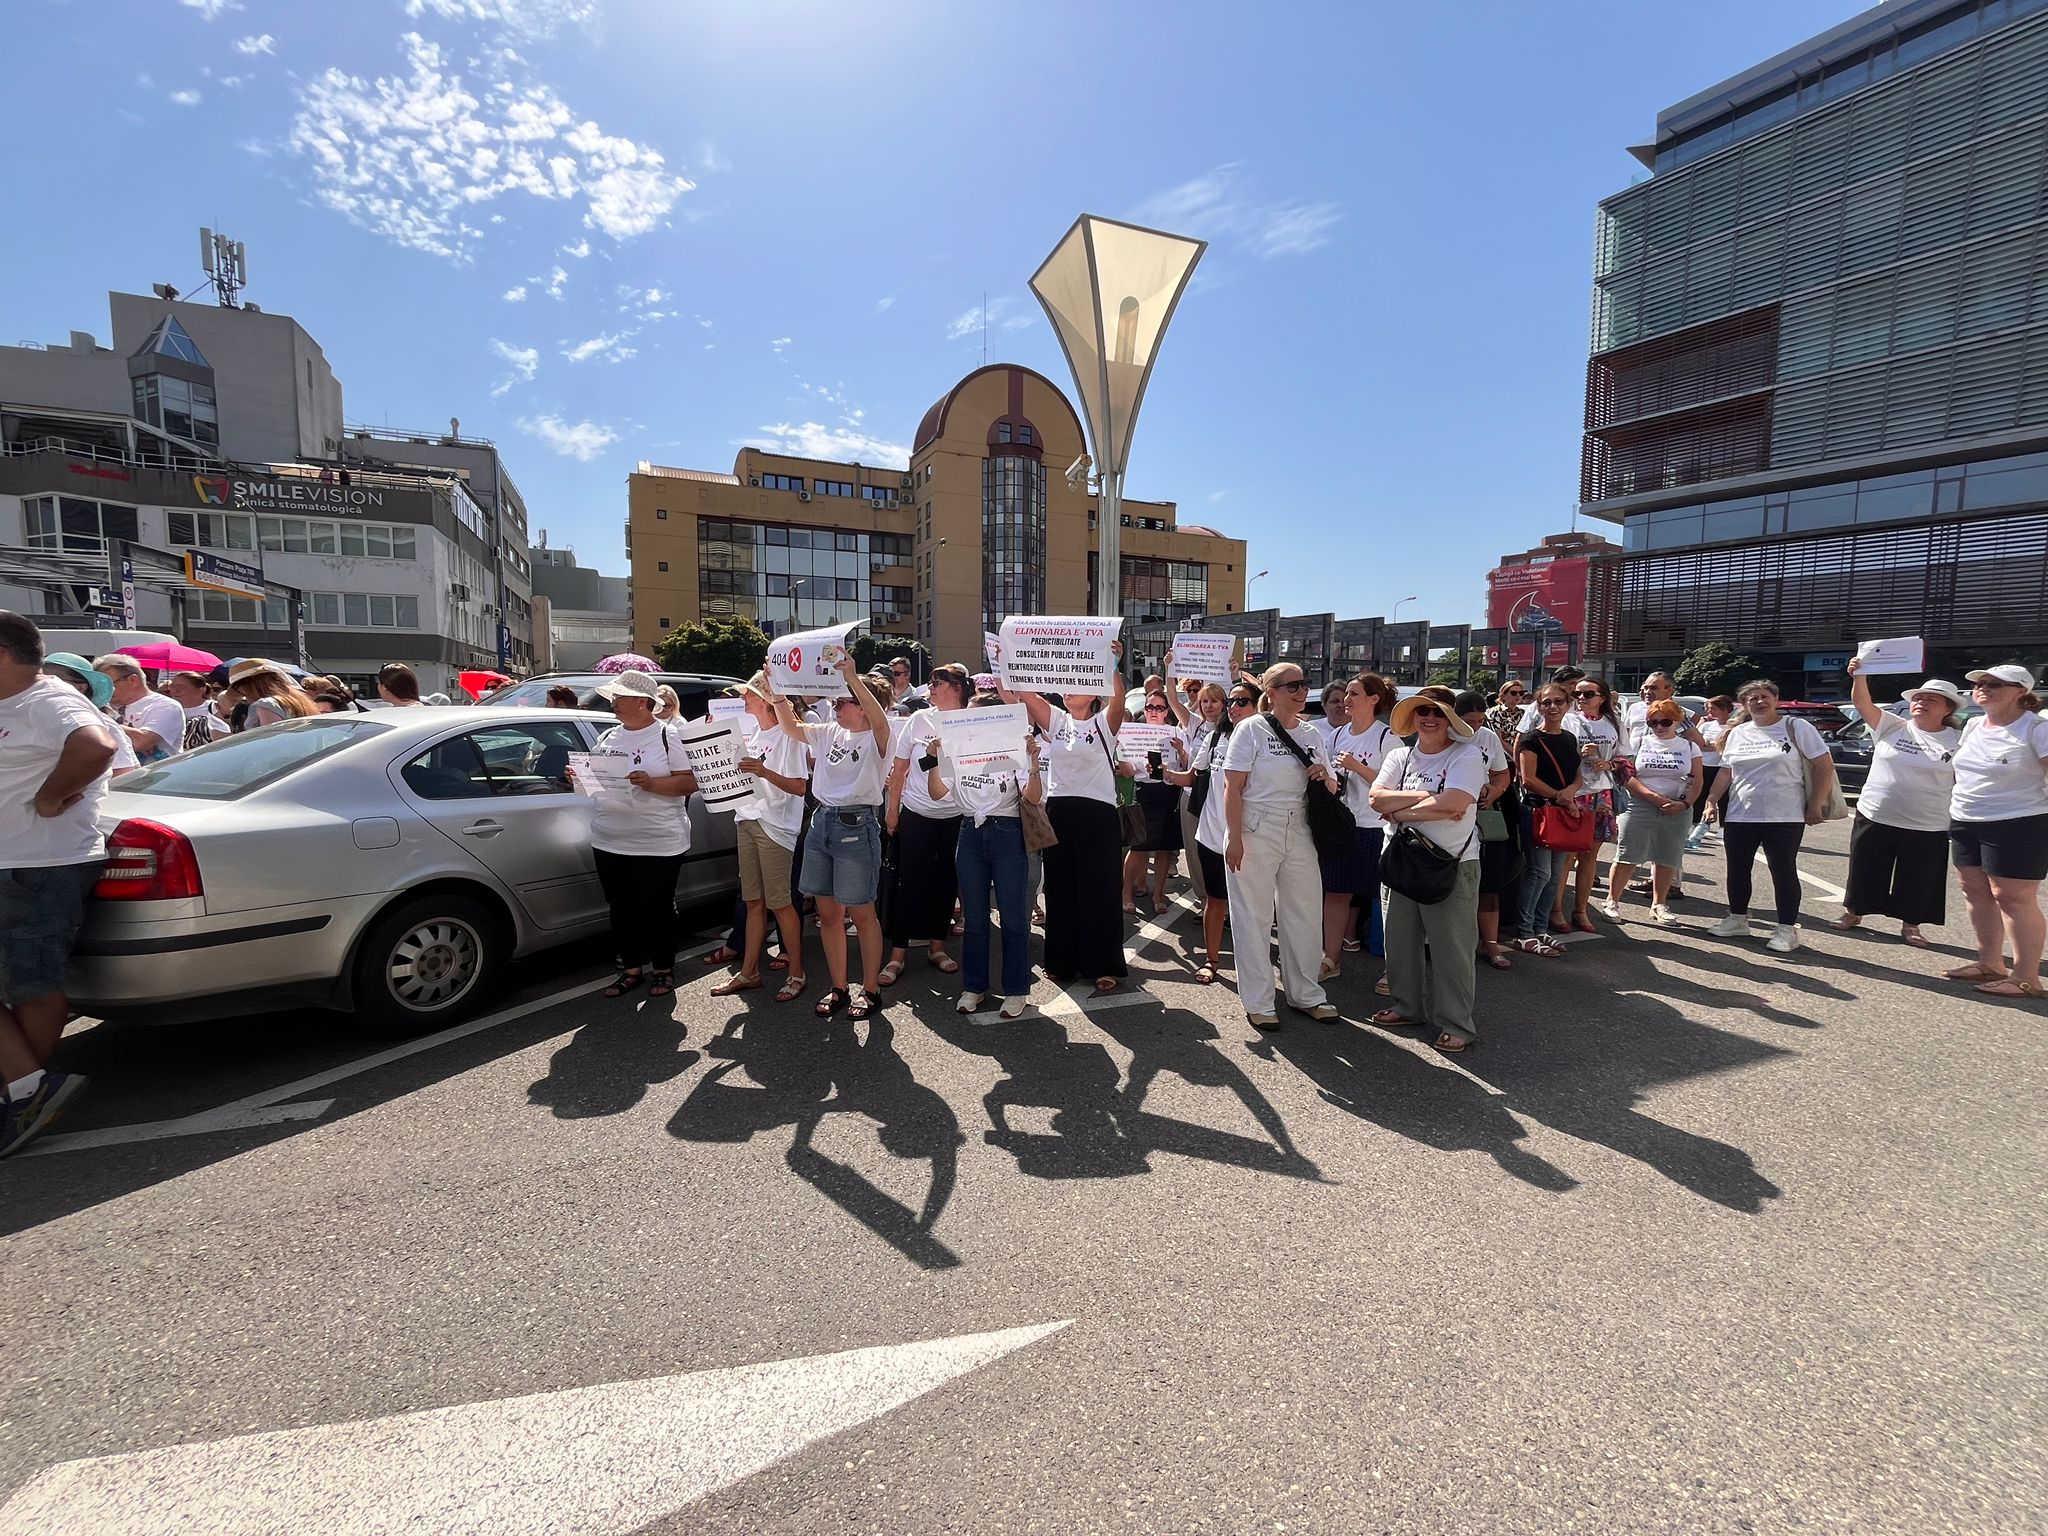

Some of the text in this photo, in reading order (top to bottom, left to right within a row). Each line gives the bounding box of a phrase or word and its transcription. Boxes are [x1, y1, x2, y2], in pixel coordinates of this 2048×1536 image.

[234, 481, 383, 506] SMILEVISION
[234, 496, 363, 514] inică stomatologică
[196, 555, 204, 568] P
[123, 562, 129, 574] P
[1015, 628, 1073, 636] ELIMINAREA
[1031, 637, 1081, 646] PREDICTIBILITATE
[772, 653, 787, 666] 404
[1016, 650, 1095, 660] CONSULTĂRI PUBLICE REALE
[1822, 658, 1846, 666] BCR
[1008, 663, 1054, 672] REINTRODUCEREA
[1055, 664, 1070, 672] LEGII
[1071, 665, 1104, 676] PREVENȚIEI
[1009, 675, 1104, 687] TERMENE DE RAPORTARE REALISTE
[711, 758, 733, 769] REALE
[960, 756, 992, 765] ELIMINAREA
[722, 777, 754, 791] REALISTE
